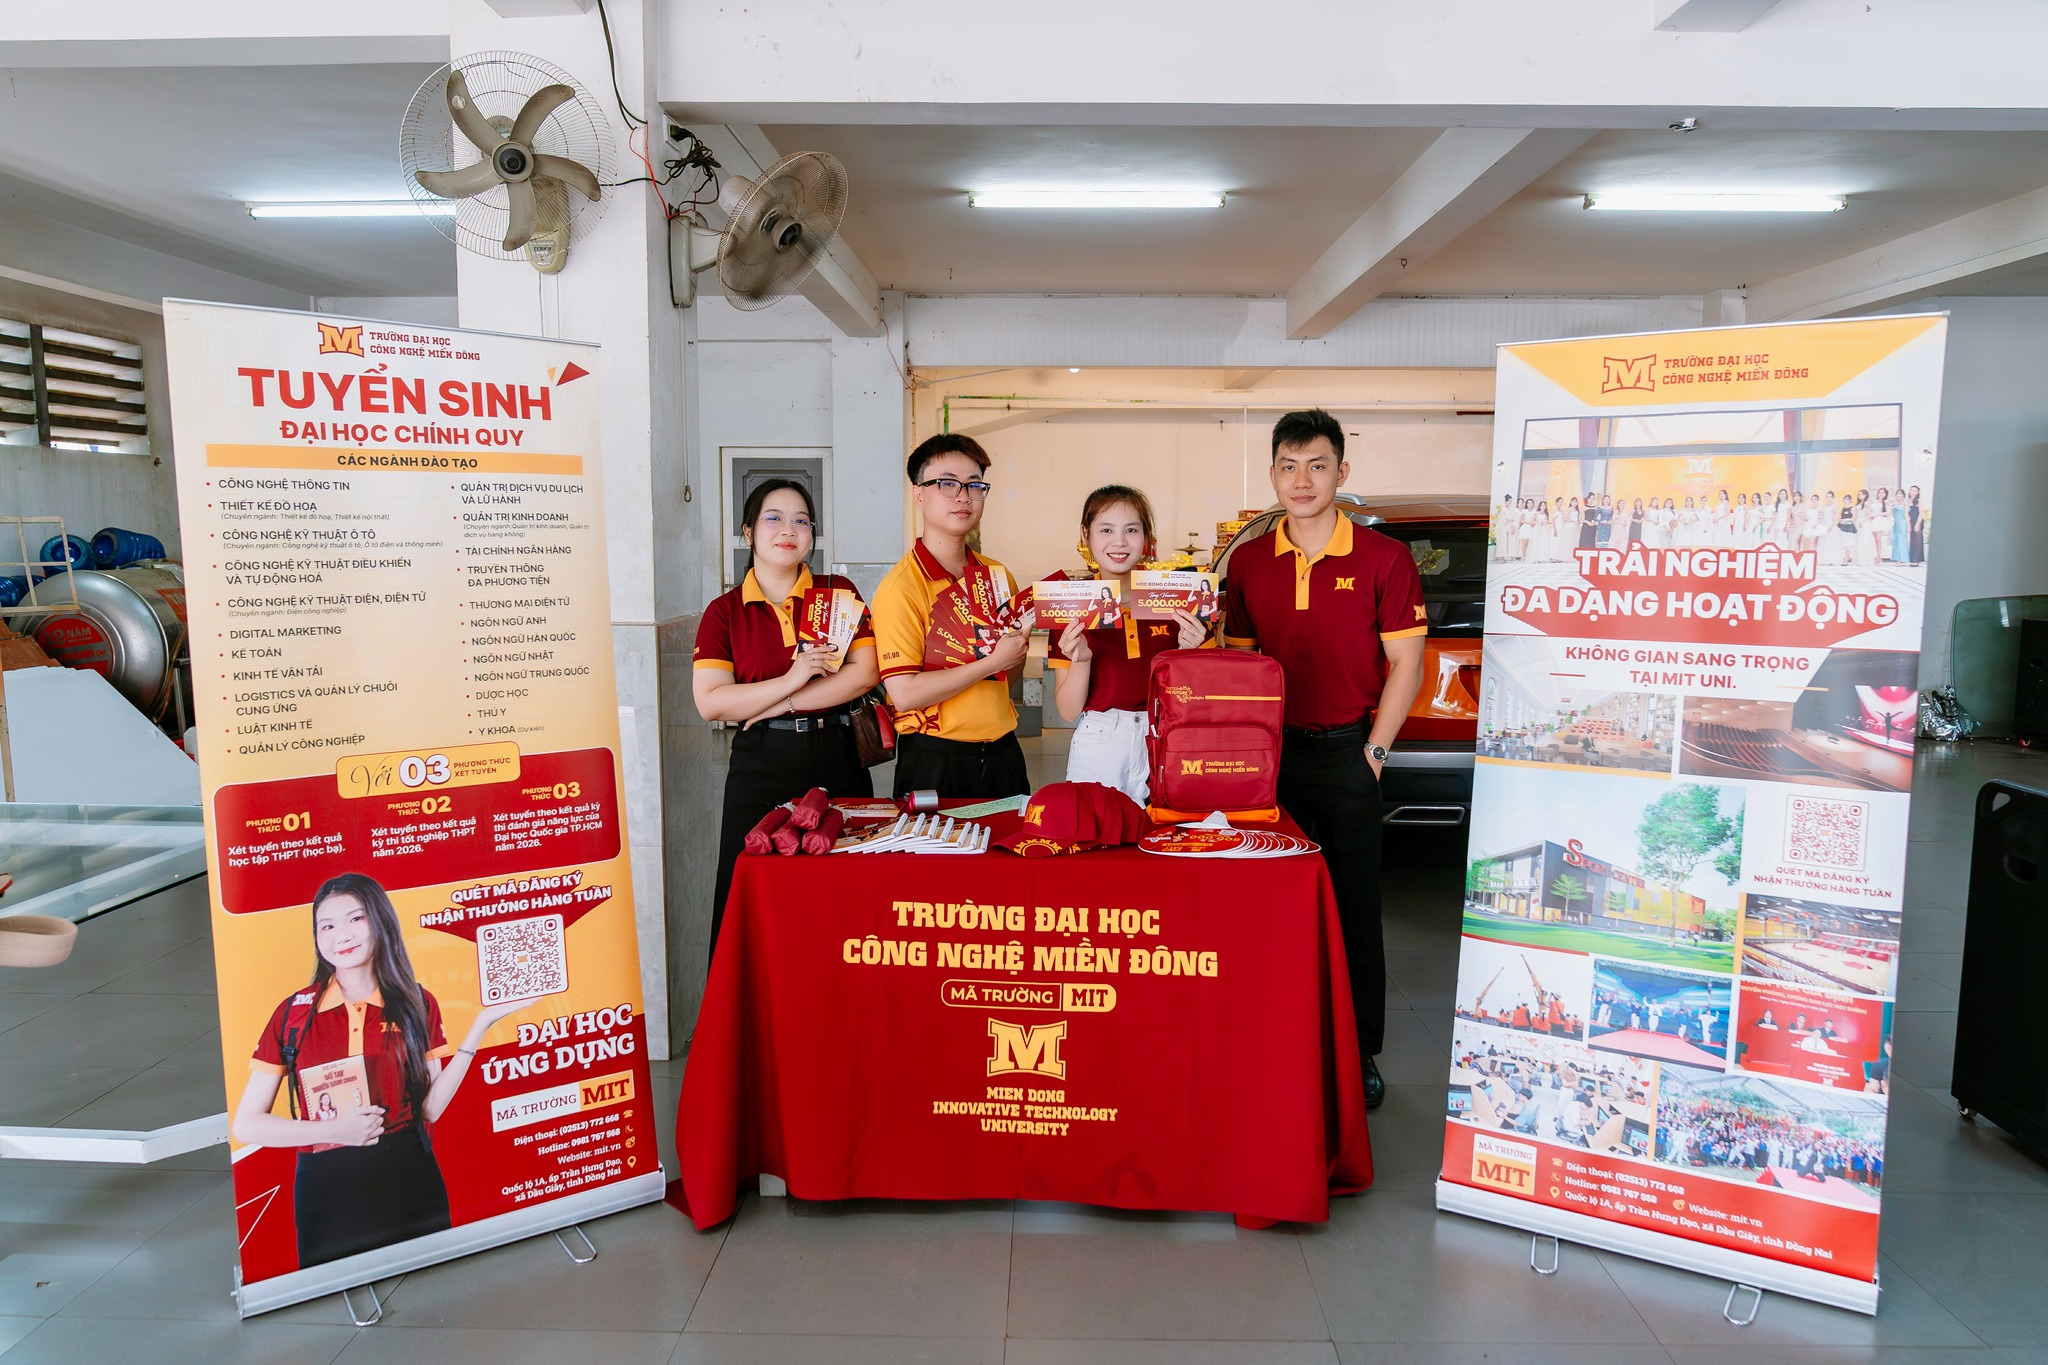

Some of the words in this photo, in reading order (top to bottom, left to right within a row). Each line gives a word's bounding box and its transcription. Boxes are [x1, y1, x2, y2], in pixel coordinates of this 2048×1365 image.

[317, 321, 365, 359] M
[369, 331, 409, 345] TRƯỜNG
[412, 335, 429, 348] ĐẠI
[432, 337, 450, 349] HỌC
[370, 344, 395, 354] CÔNG
[399, 347, 424, 358] NGHỆ
[428, 346, 452, 358] MIỀN
[455, 350, 479, 360] ĐÔNG
[1664, 355, 1713, 369] TRƯỜNG
[1718, 355, 1740, 367] ĐẠI
[1745, 354, 1769, 366] HỌC
[1602, 354, 1657, 394] M
[1663, 372, 1694, 385] CÔNG
[1698, 370, 1732, 384] NGHỆ
[1736, 367, 1770, 381] MIỀN
[1774, 367, 1809, 380] ĐÔNG
[237, 363, 428, 415] TUYỂN
[438, 380, 553, 421] SINH
[279, 421, 326, 444] ĐẠI
[332, 423, 387, 445] HỌC
[395, 424, 469, 444] CHÍNH
[475, 428, 523, 446] QUY
[337, 453, 366, 465] CÁC
[370, 454, 418, 466] NGÀNH
[421, 455, 448, 467] ĐÀO
[451, 458, 477, 469] TẠO
[218, 477, 253, 488] CÔNG
[257, 478, 288, 490] NGHỆ
[290, 478, 330, 489] THÔNG
[460, 481, 490, 491] QUẢN
[492, 483, 507, 493] TRỊ
[510, 483, 532, 493] DỊCH
[534, 484, 547, 493] VỤ
[549, 484, 561, 492] DU
[564, 485, 583, 494] LỊCH
[220, 499, 254, 510] THIẾT
[257, 499, 271, 510] KẾ
[274, 499, 290, 510] ĐỒ
[293, 502, 317, 512] HOẠ
[461, 494, 475, 503] VÀ
[477, 495, 490, 503] LỮ
[1575, 542, 1656, 577] TRẢI
[1664, 542, 1816, 586] NGHIỆM
[975, 571, 990, 616] 5.000.000
[1138, 599, 1188, 608] 5.000.000
[812, 593, 823, 632] 5.000.000
[1041, 609, 1089, 617] 5.000.000
[1502, 586, 1551, 614] ĐA
[1559, 588, 1659, 622] DẠNG
[1666, 591, 1772, 627] HOẠT
[1776, 588, 1898, 630] ĐỘNG
[470, 617, 499, 626] NGÔN
[502, 616, 523, 625] NGỮ
[230, 629, 274, 638] DIGITAL
[277, 626, 341, 636] MARKETING
[1566, 644, 1630, 662] KHÔNG
[1634, 650, 1678, 664] GIAN
[1683, 652, 1736, 666] SANG
[1741, 654, 1809, 672] TRỌNG
[1630, 670, 1658, 687] TẠI
[1662, 673, 1695, 686] MIT
[1700, 675, 1737, 689] UNI.
[476, 690, 504, 700] DƯỢC
[507, 688, 528, 698] HỌC
[477, 707, 497, 717] THÚ
[487, 725, 515, 734] KHOA
[399, 754, 451, 787] 03
[454, 760, 487, 768] PHƯƠNG
[489, 757, 511, 765] THỨC
[455, 769, 470, 777] XÉT
[1181, 759, 1203, 776] M
[351, 756, 393, 795] Với
[246, 817, 282, 827] PHƯƠNG
[257, 824, 280, 833] THỨC
[283, 812, 311, 831] 01
[228, 846, 246, 855] Xét
[281, 840, 304, 849] theo
[306, 835, 321, 845] kết
[324, 832, 342, 844] quả
[229, 858, 249, 867] học
[252, 855, 269, 865] tập
[272, 850, 300, 861] THPT
[303, 847, 324, 858] (học
[327, 844, 346, 853] bạ).
[451, 884, 491, 903] QUÉT
[493, 880, 518, 896] MÃ
[518, 874, 561, 892] ĐĂNG
[563, 870, 583, 886] KÝ
[420, 908, 464, 927] NHẬN
[465, 898, 529, 918] THƯỞNG
[532, 892, 573, 910] HÀNG
[575, 885, 612, 903] TUẦN
[892, 899, 1026, 931] TRƯỜNG
[1034, 906, 1089, 937] ĐẠI
[1098, 908, 1160, 939] HỌC
[842, 934, 928, 967] CÔNG
[936, 940, 1024, 975] NGHỆ
[1033, 937, 1120, 973] MIỀN
[1129, 944, 1218, 977] ĐÔNG
[950, 984, 978, 1001] MÃ
[982, 986, 1054, 1004] TRƯỜNG
[1071, 988, 1108, 1007] MIT
[517, 1016, 569, 1048] ĐẠI
[574, 1003, 633, 1035] HỌC
[481, 1052, 550, 1084] ỨNG
[555, 1033, 635, 1069] DỤNG
[986, 1017, 1067, 1080] M
[496, 1105, 518, 1122] MÃ
[521, 1094, 577, 1115] TRƯỜNG
[582, 1078, 629, 1105] MIT
[986, 1086, 1024, 1101] MIEN
[1027, 1089, 1065, 1103] DONG
[932, 1101, 1020, 1117] INNOVATIVE
[1024, 1104, 1118, 1121] TECHNOLOGY
[514, 1137, 533, 1146] Điện
[535, 1128, 558, 1140] thoại:
[560, 1120, 588, 1135] (02513)
[590, 1117, 604, 1127] 772
[605, 1114, 619, 1123] 668
[980, 1119, 1069, 1136] UNIVERSITY
[538, 1142, 570, 1155] Hotline:
[571, 1136, 589, 1147] 0981
[591, 1132, 605, 1141] 767
[557, 1150, 592, 1165] Website:
[594, 1142, 621, 1155] mit.vn
[1479, 1141, 1492, 1150] MÃ
[1477, 1160, 1530, 1187] MIT
[1689, 1203, 1728, 1219] Website:
[1730, 1214, 1763, 1228] mit.vn
